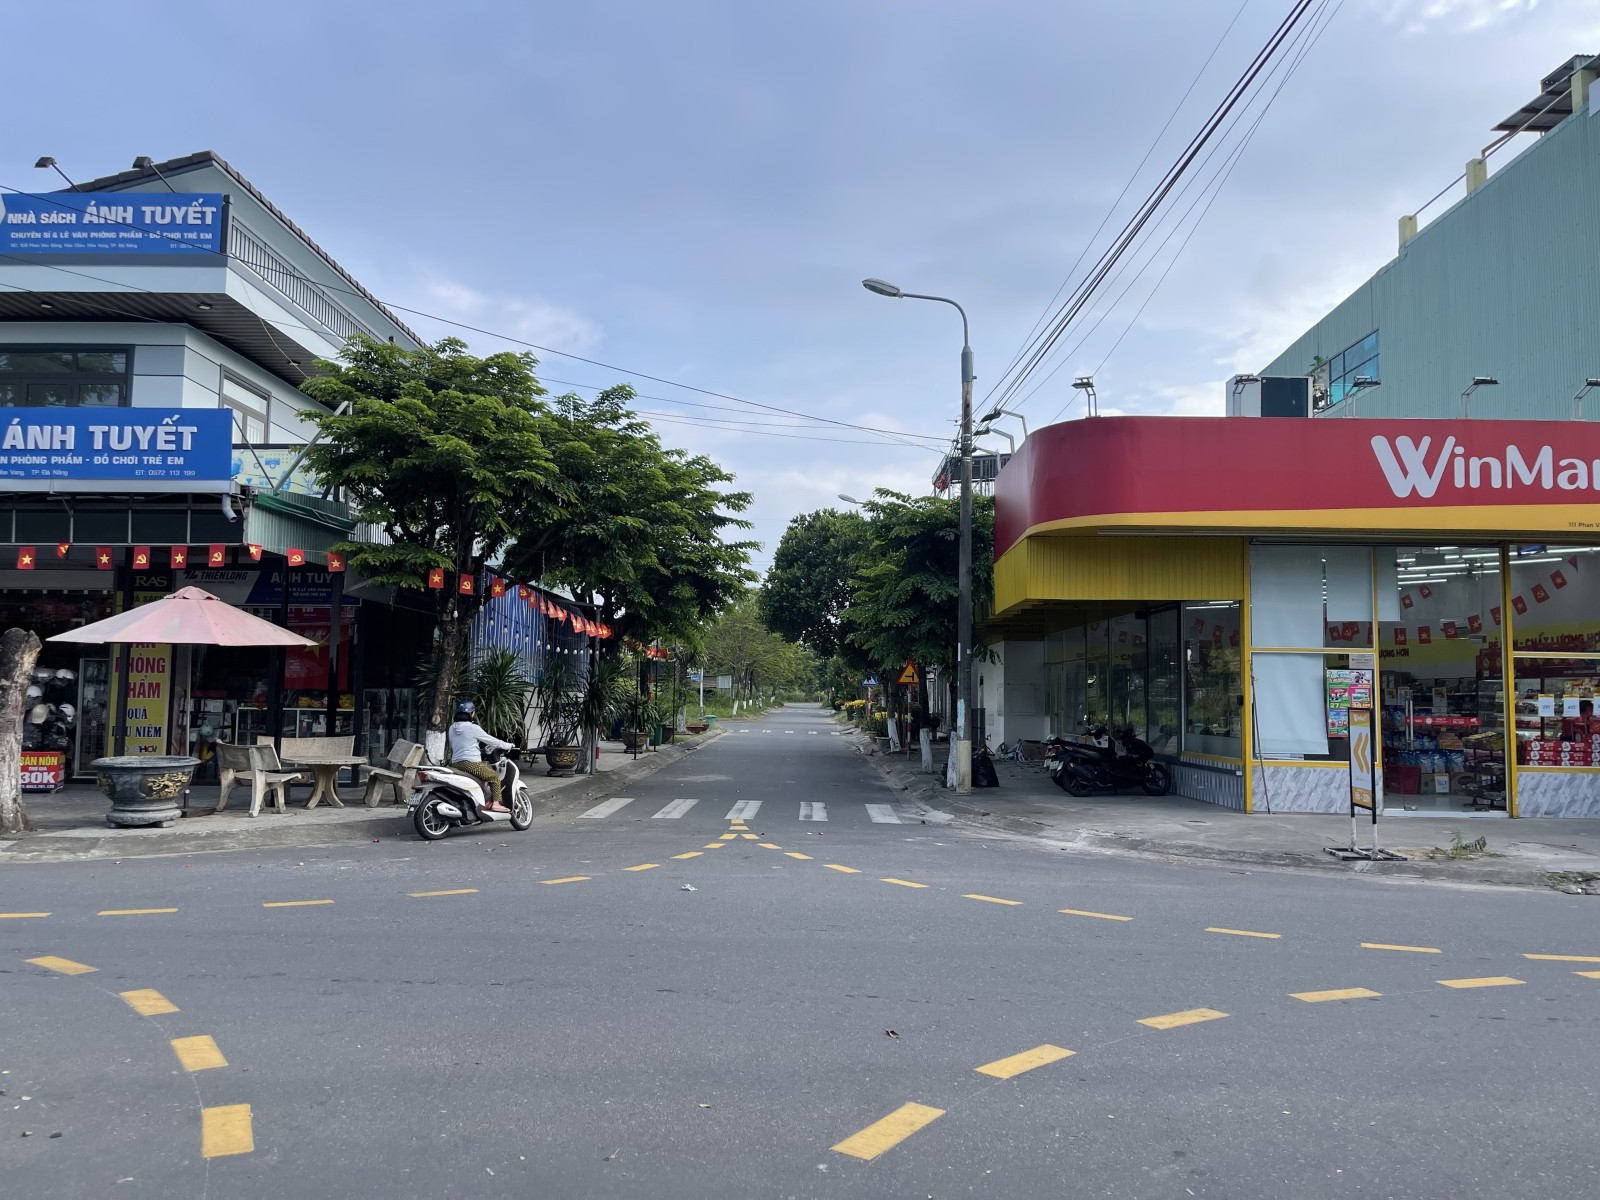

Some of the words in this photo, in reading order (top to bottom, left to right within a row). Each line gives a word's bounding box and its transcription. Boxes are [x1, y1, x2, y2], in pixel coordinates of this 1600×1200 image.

[8, 210, 36, 224] NHÀ
[40, 210, 76, 224] SÁCH
[83, 200, 133, 224] ÁNH
[141, 198, 216, 225] TUYẾT
[2, 418, 75, 450] ÁNH
[88, 414, 198, 451] TUYẾT
[11, 453, 48, 465] PHÒNG
[51, 452, 83, 465] PHẨM
[93, 453, 110, 465] ĐỒ
[112, 455, 139, 465] CHƠI
[142, 454, 163, 465] TRẺ
[167, 456, 184, 465] EM
[133, 576, 168, 586] RAS
[200, 571, 249, 580] THIENLONG
[128, 675, 161, 698] HẨM
[127, 706, 148, 720] QUÀ
[135, 723, 162, 740] NIỆM
[39, 755, 58, 766] NÓN
[20, 771, 56, 784] 30K
